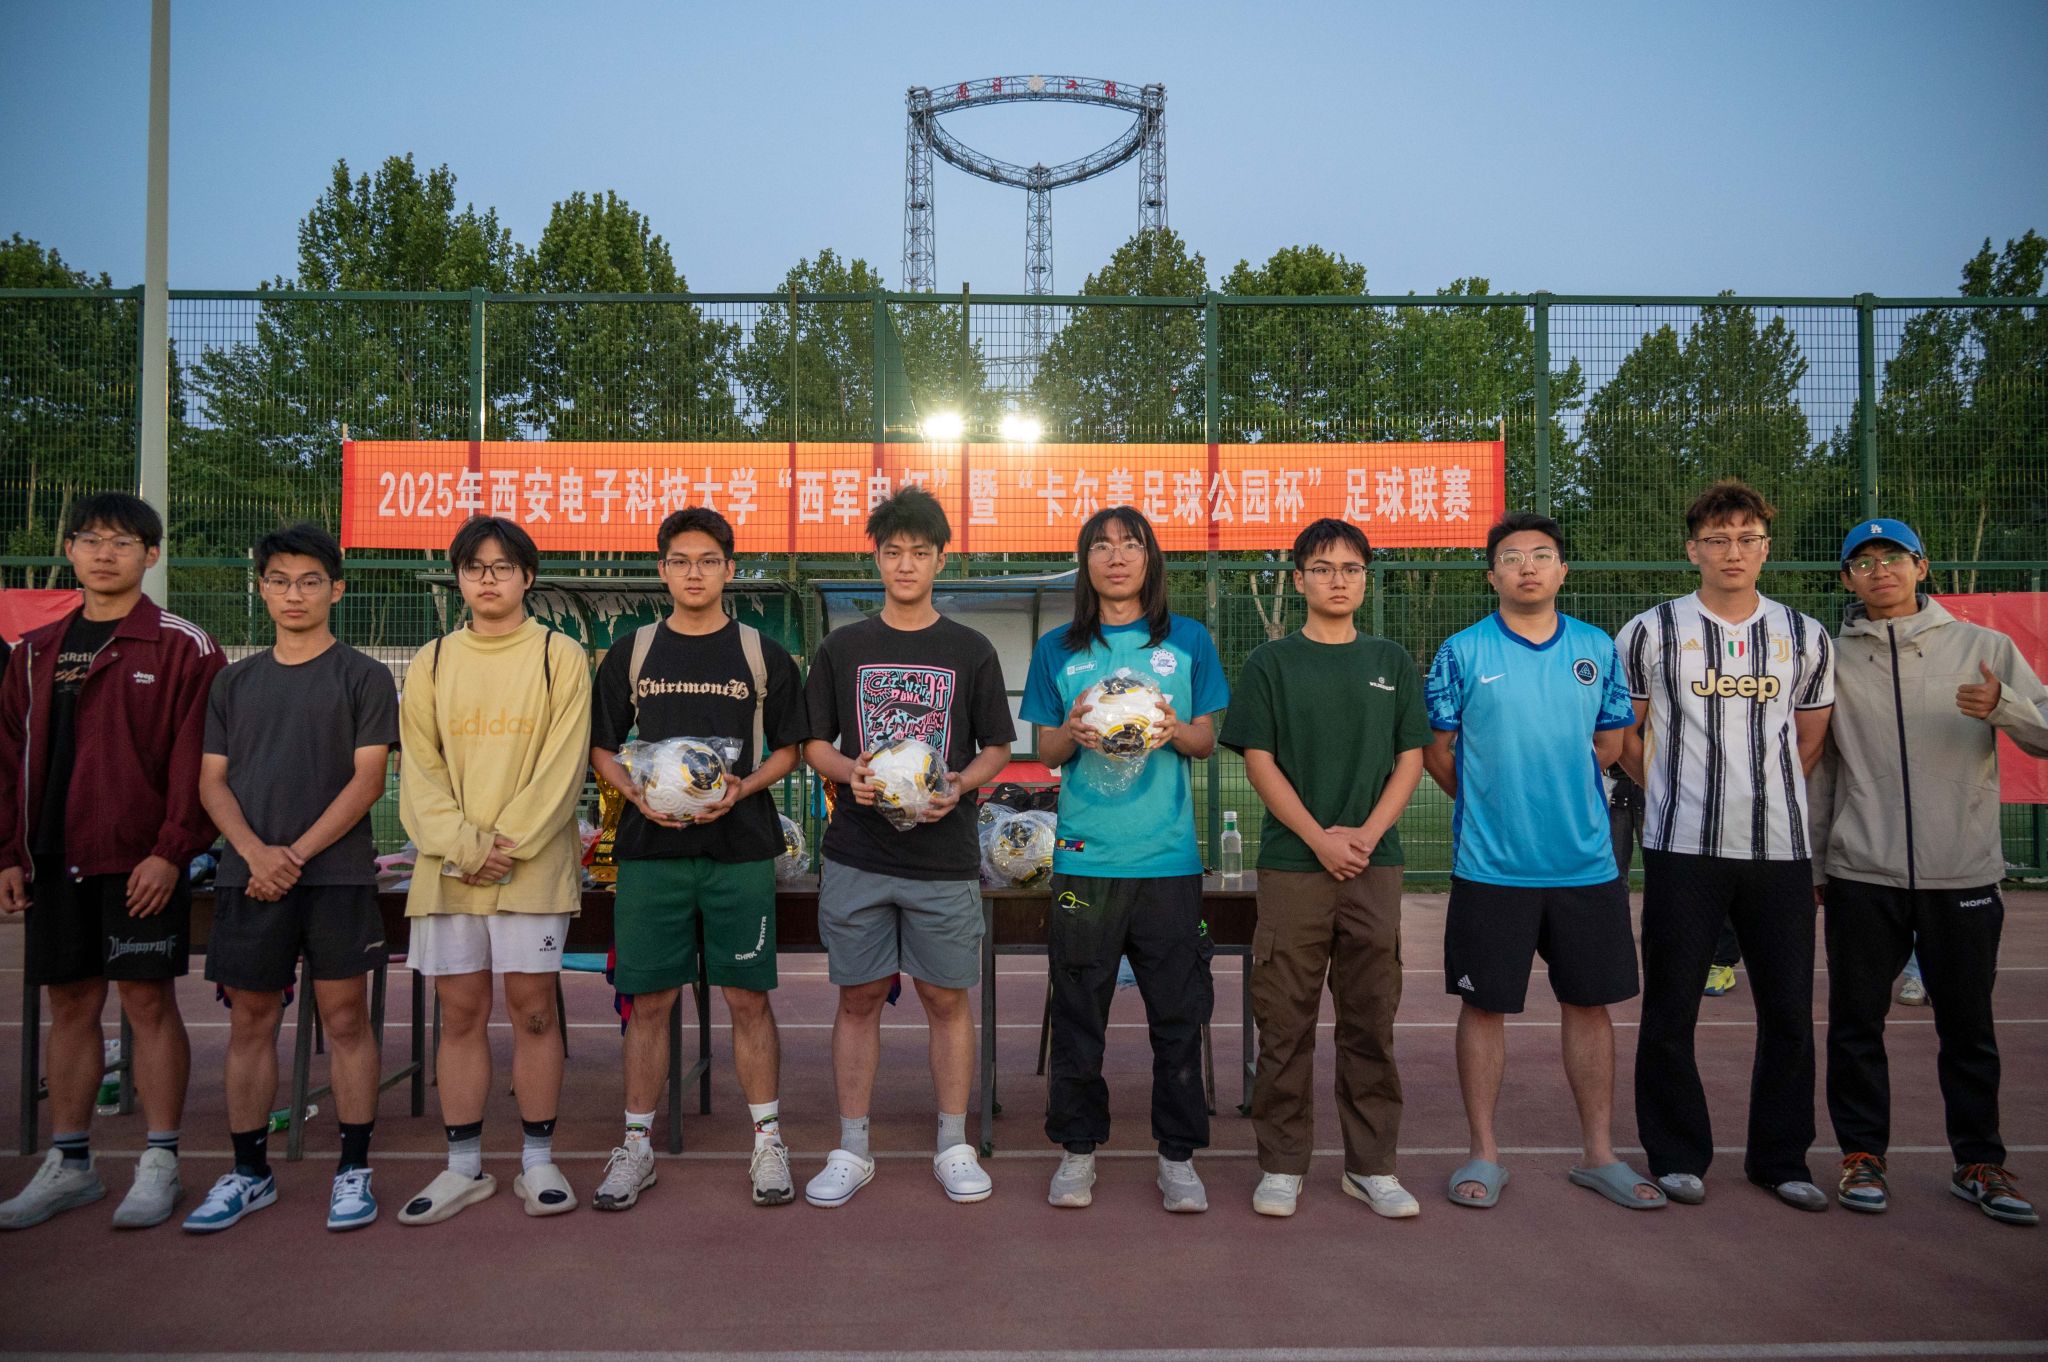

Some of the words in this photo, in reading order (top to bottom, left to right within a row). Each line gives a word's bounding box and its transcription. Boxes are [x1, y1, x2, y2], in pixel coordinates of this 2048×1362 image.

[133, 671, 155, 681] Jeep
[1691, 667, 1781, 704] Jeep
[448, 706, 534, 736] adidas
